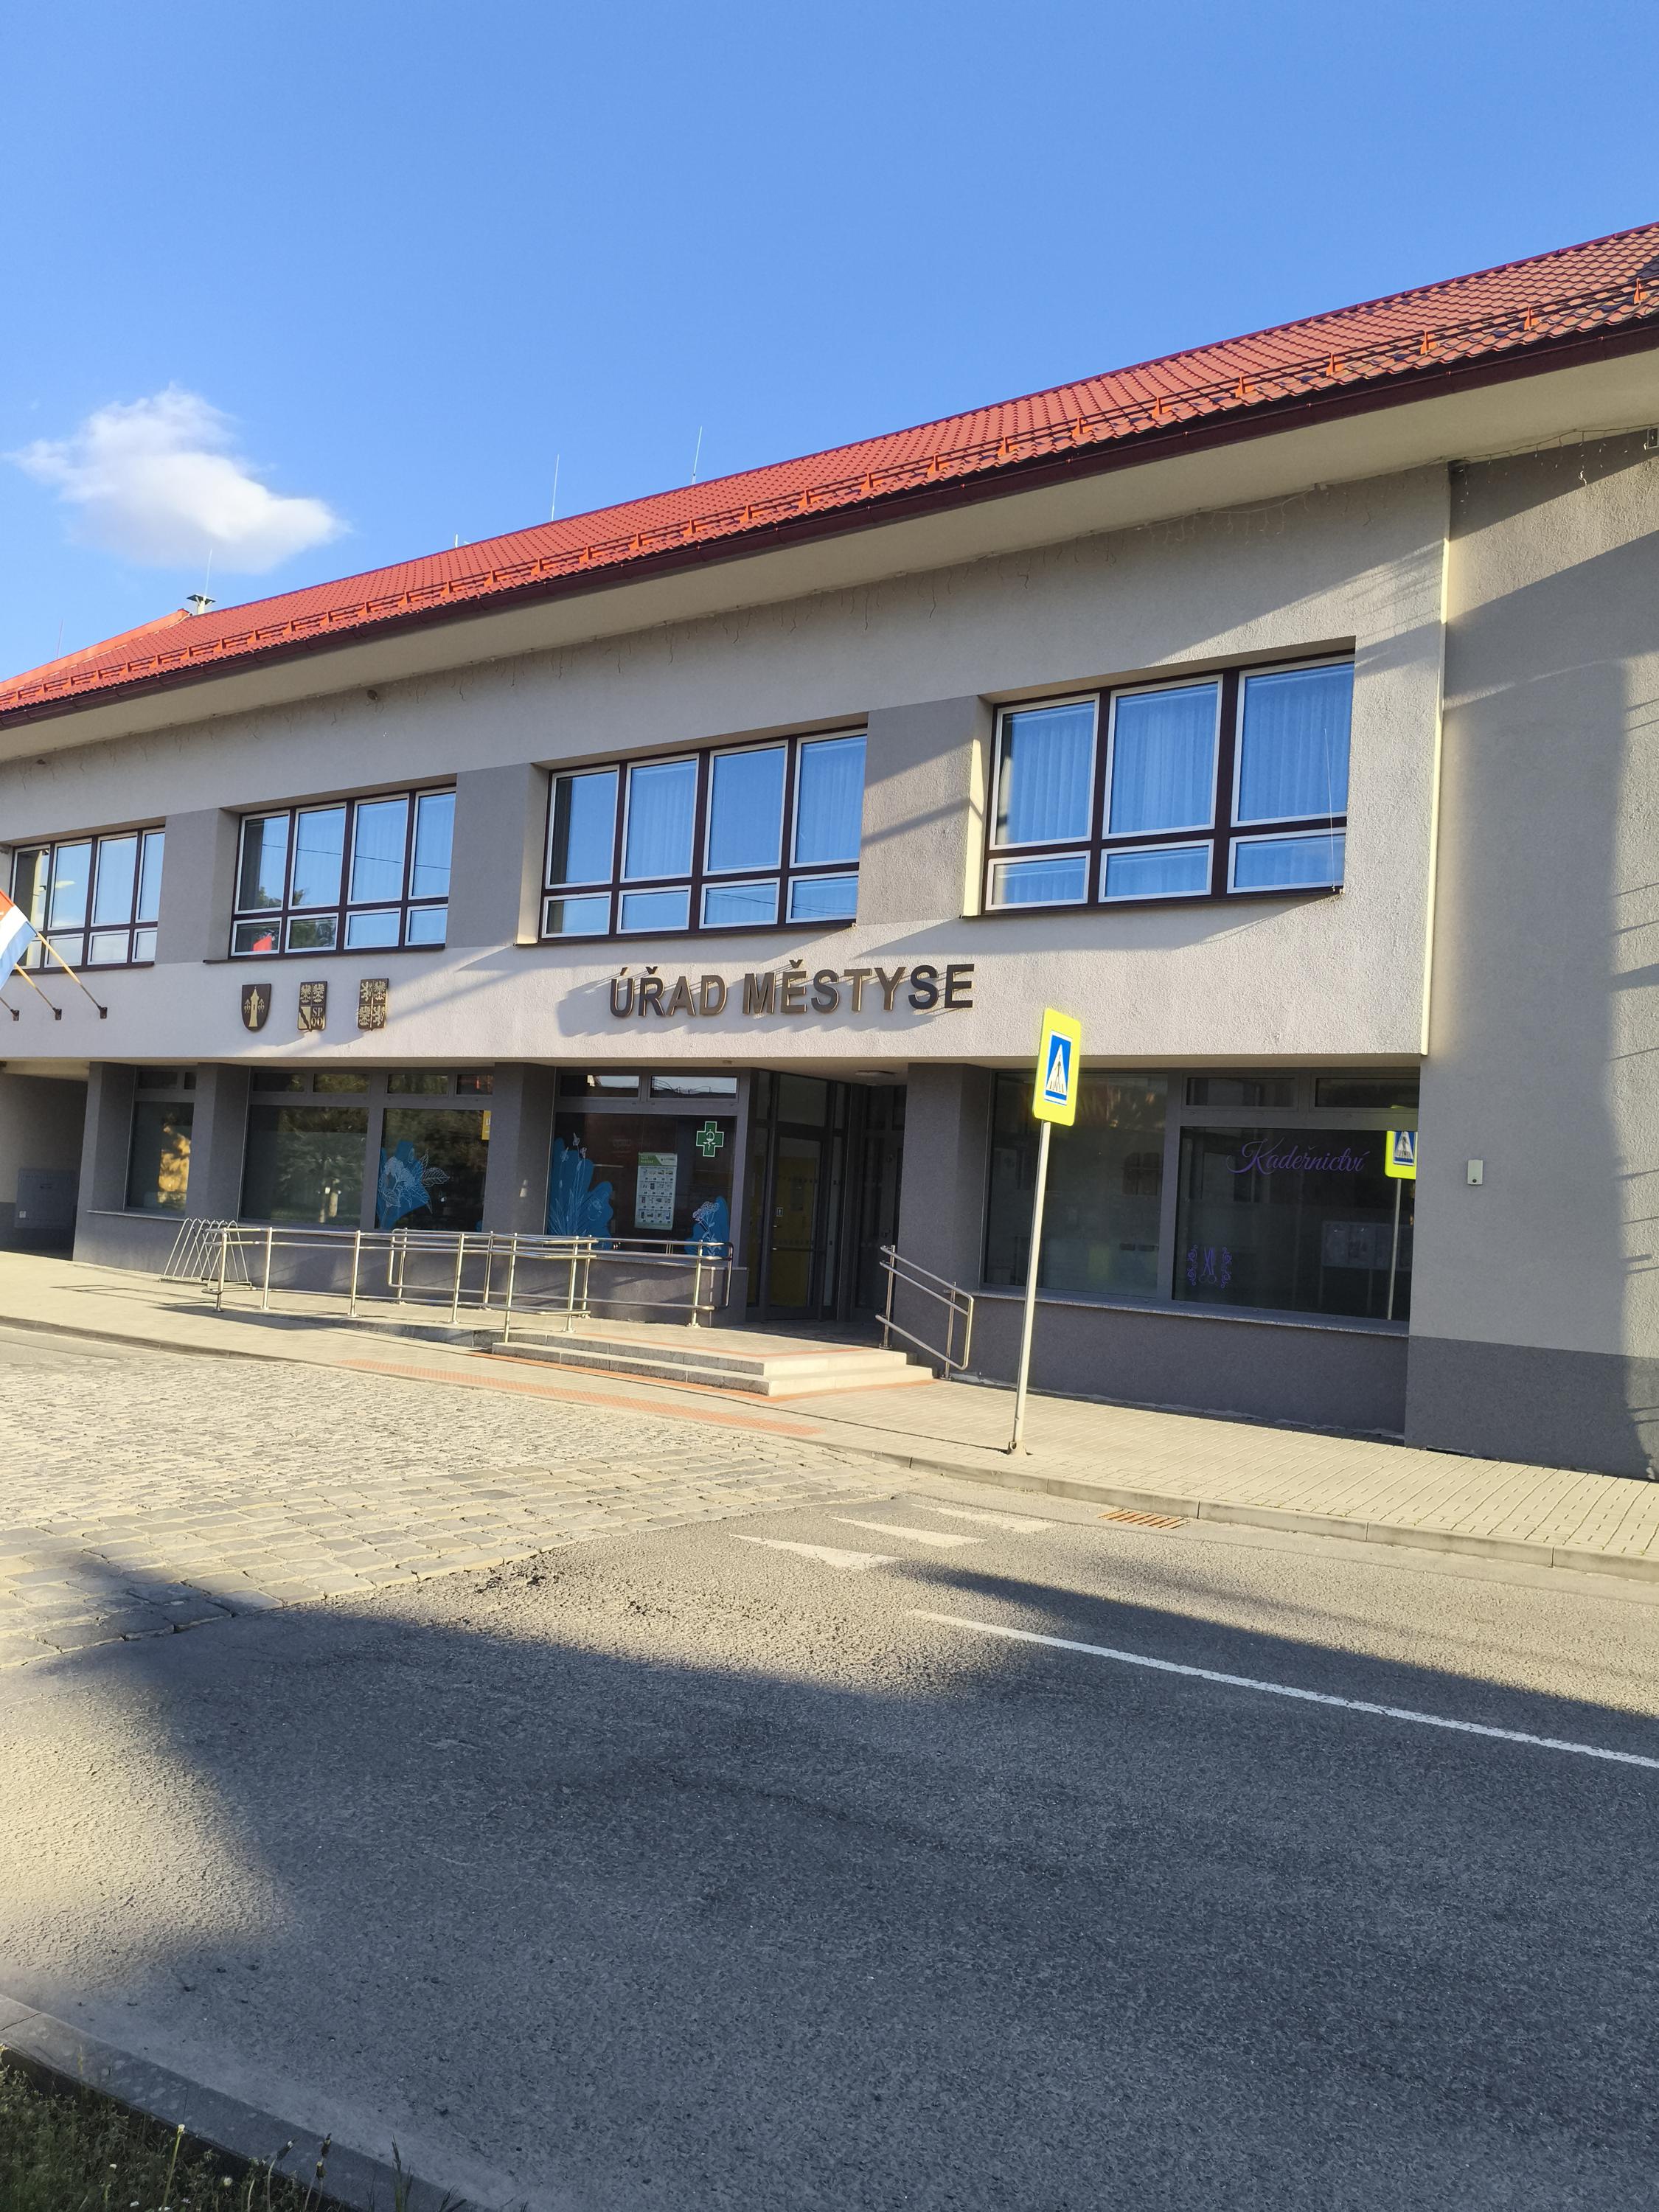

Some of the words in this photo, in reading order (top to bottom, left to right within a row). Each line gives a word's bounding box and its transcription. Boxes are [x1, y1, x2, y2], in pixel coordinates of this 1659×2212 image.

[610, 966, 728, 1017] ÚŘAD
[742, 959, 975, 1014] MĚSTYSE
[312, 1007, 323, 1017] SP
[1227, 1137, 1370, 1175] Kadeřnictví
